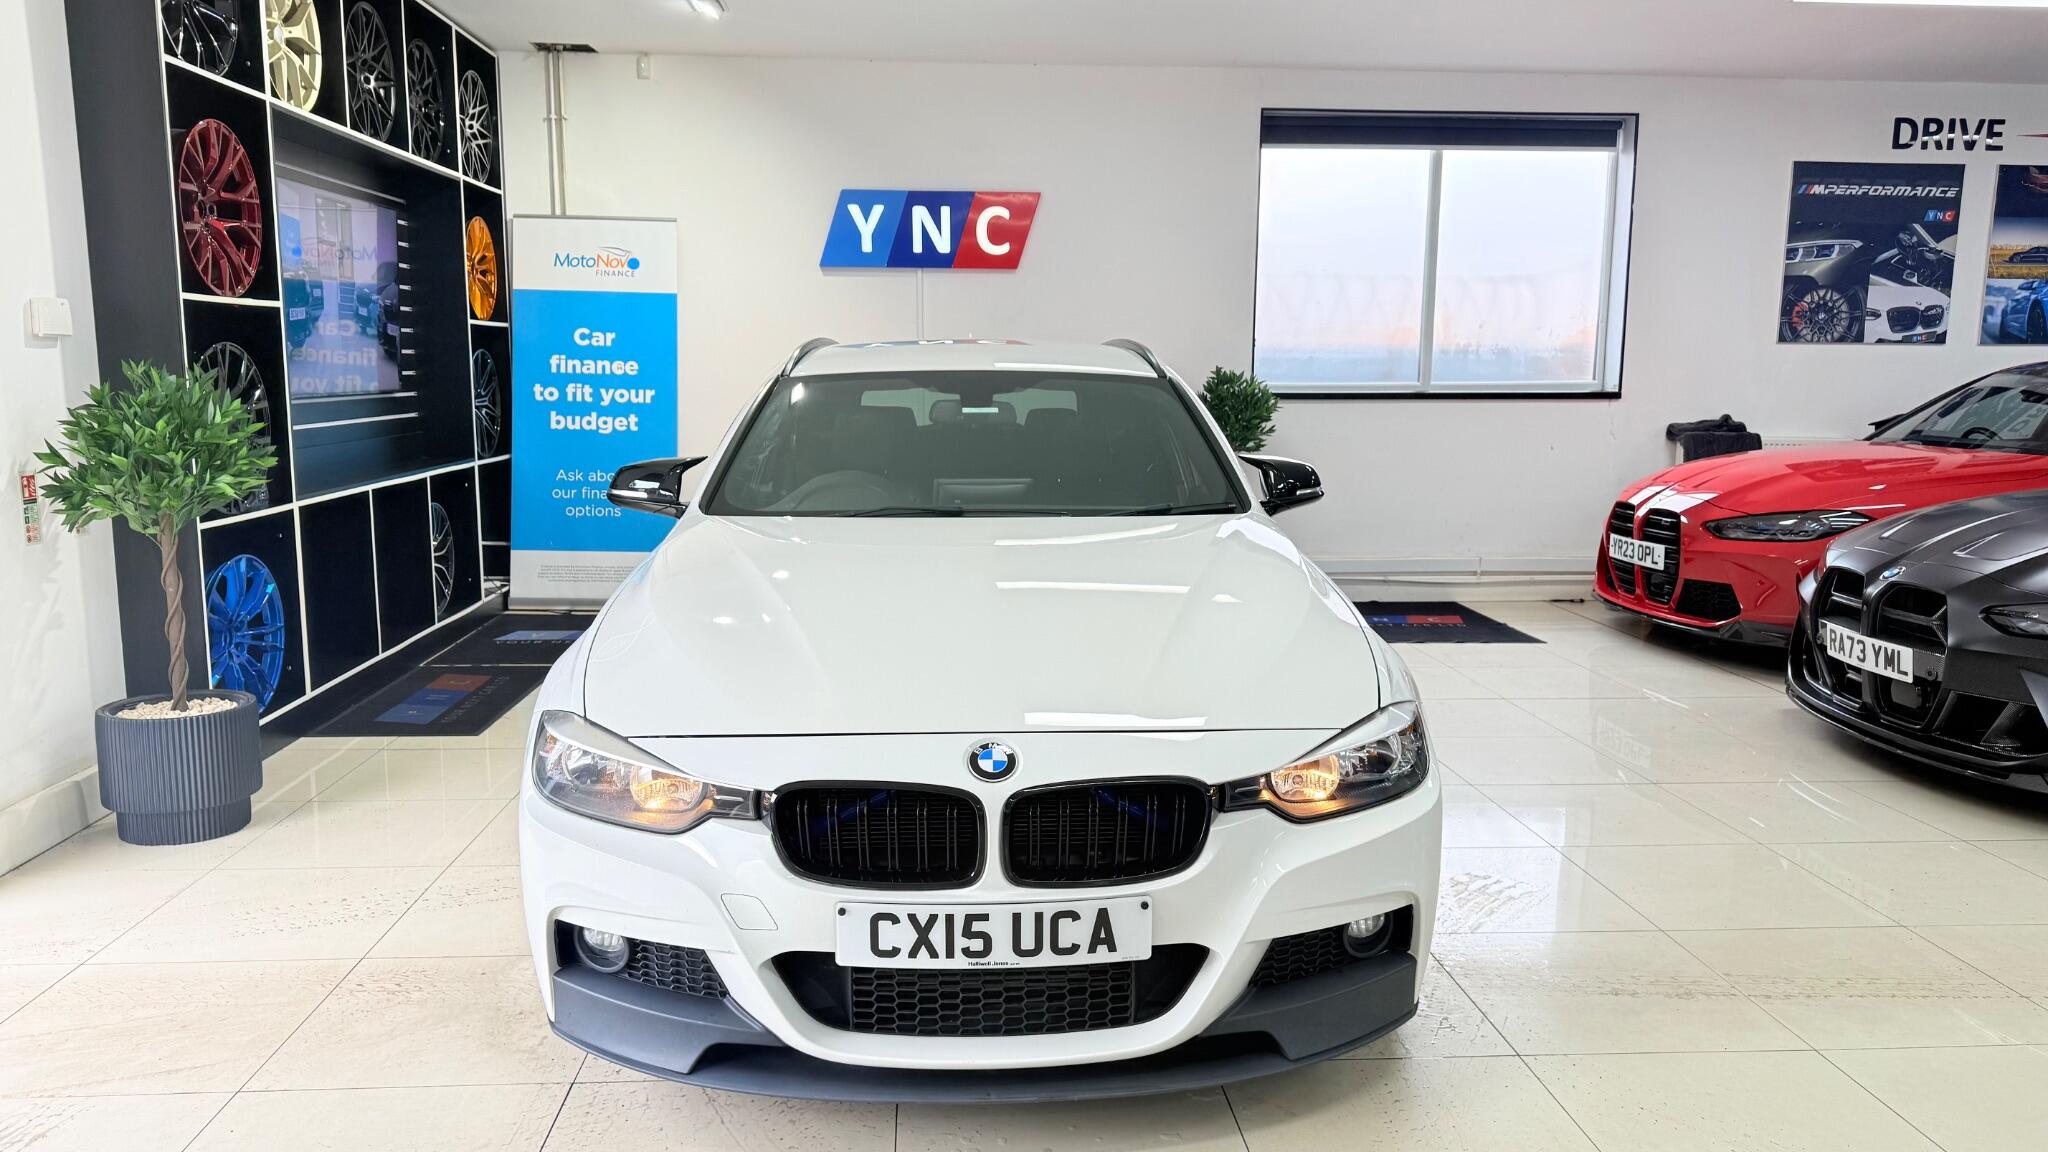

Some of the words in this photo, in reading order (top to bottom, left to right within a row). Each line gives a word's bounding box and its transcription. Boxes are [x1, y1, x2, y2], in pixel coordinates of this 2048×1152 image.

[1892, 117, 2006, 151] DRIVE
[1928, 211, 1954, 221] YNC
[847, 204, 1011, 255] YNC
[553, 252, 640, 271] MotoNovo
[595, 270, 636, 278] FINANCE
[573, 328, 616, 346] Car
[550, 355, 639, 375] finance
[533, 384, 559, 401] to
[566, 384, 593, 402] fit
[600, 387, 656, 406] your
[550, 411, 639, 434] budget
[556, 469, 583, 482] Ask
[588, 470, 614, 482] abo
[552, 489, 577, 499] our
[581, 486, 608, 500] fina
[565, 504, 622, 518] options
[1612, 536, 1635, 560] YR23
[1637, 544, 1659, 565] OPL
[1829, 628, 1866, 663] RA73
[1871, 643, 1909, 677] YML
[869, 912, 993, 960] CX15
[1011, 907, 1118, 958] UCA
